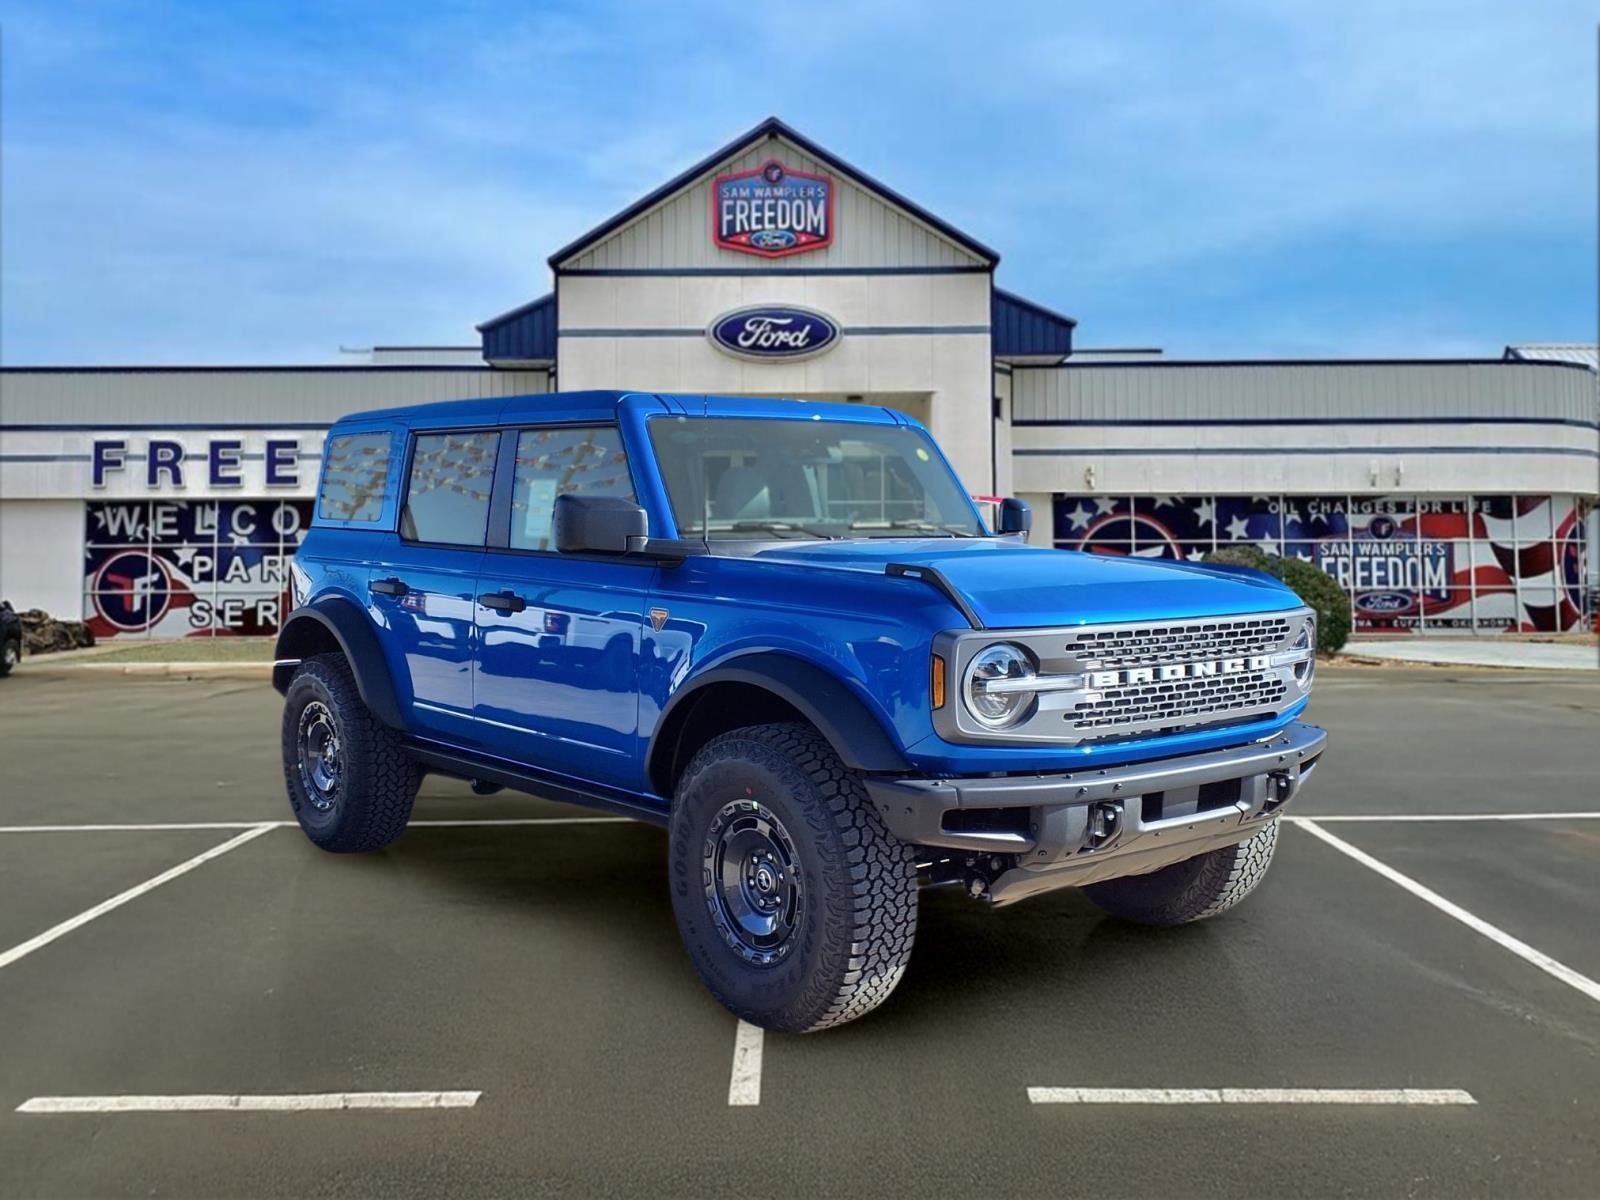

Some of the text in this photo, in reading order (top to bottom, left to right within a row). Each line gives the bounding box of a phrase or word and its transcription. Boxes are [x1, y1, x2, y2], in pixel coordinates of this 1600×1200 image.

[722, 187, 750, 198] SAM
[721, 199, 825, 236] FREEDOM
[737, 316, 811, 348] Ford
[92, 439, 299, 486] FREE
[103, 504, 301, 537] WELCO
[1268, 501, 1491, 514] OIL CHANGES FOR LIFE
[1320, 542, 1352, 556] SAM
[192, 555, 288, 582] PAR
[1321, 556, 1447, 599] FREEDOM
[190, 600, 279, 628] SER
[1365, 594, 1400, 609] Ford
[1090, 654, 1272, 688] BRONCO
